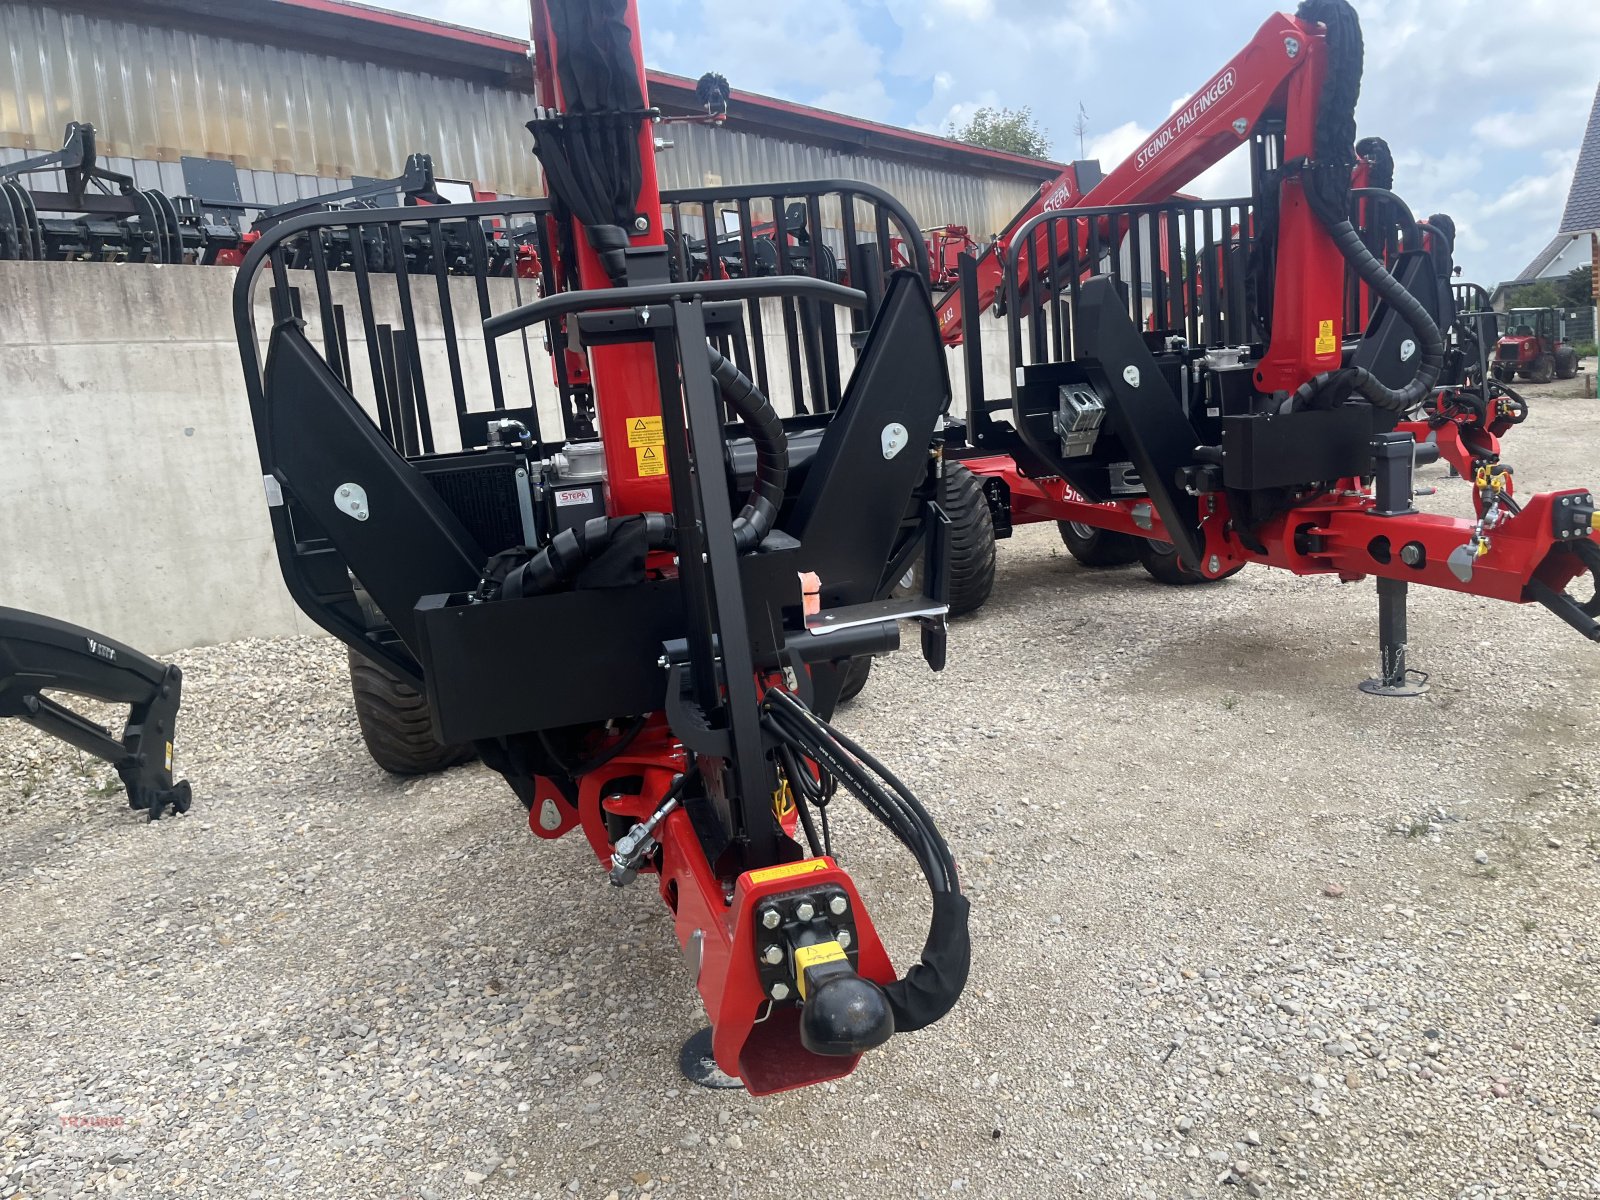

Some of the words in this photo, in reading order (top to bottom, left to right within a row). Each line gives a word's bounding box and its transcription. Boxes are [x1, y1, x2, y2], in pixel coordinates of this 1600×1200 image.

[1136, 71, 1234, 168] STEINDL-PALFINGER
[1043, 185, 1070, 213] STEPA
[561, 491, 587, 501] STEPA
